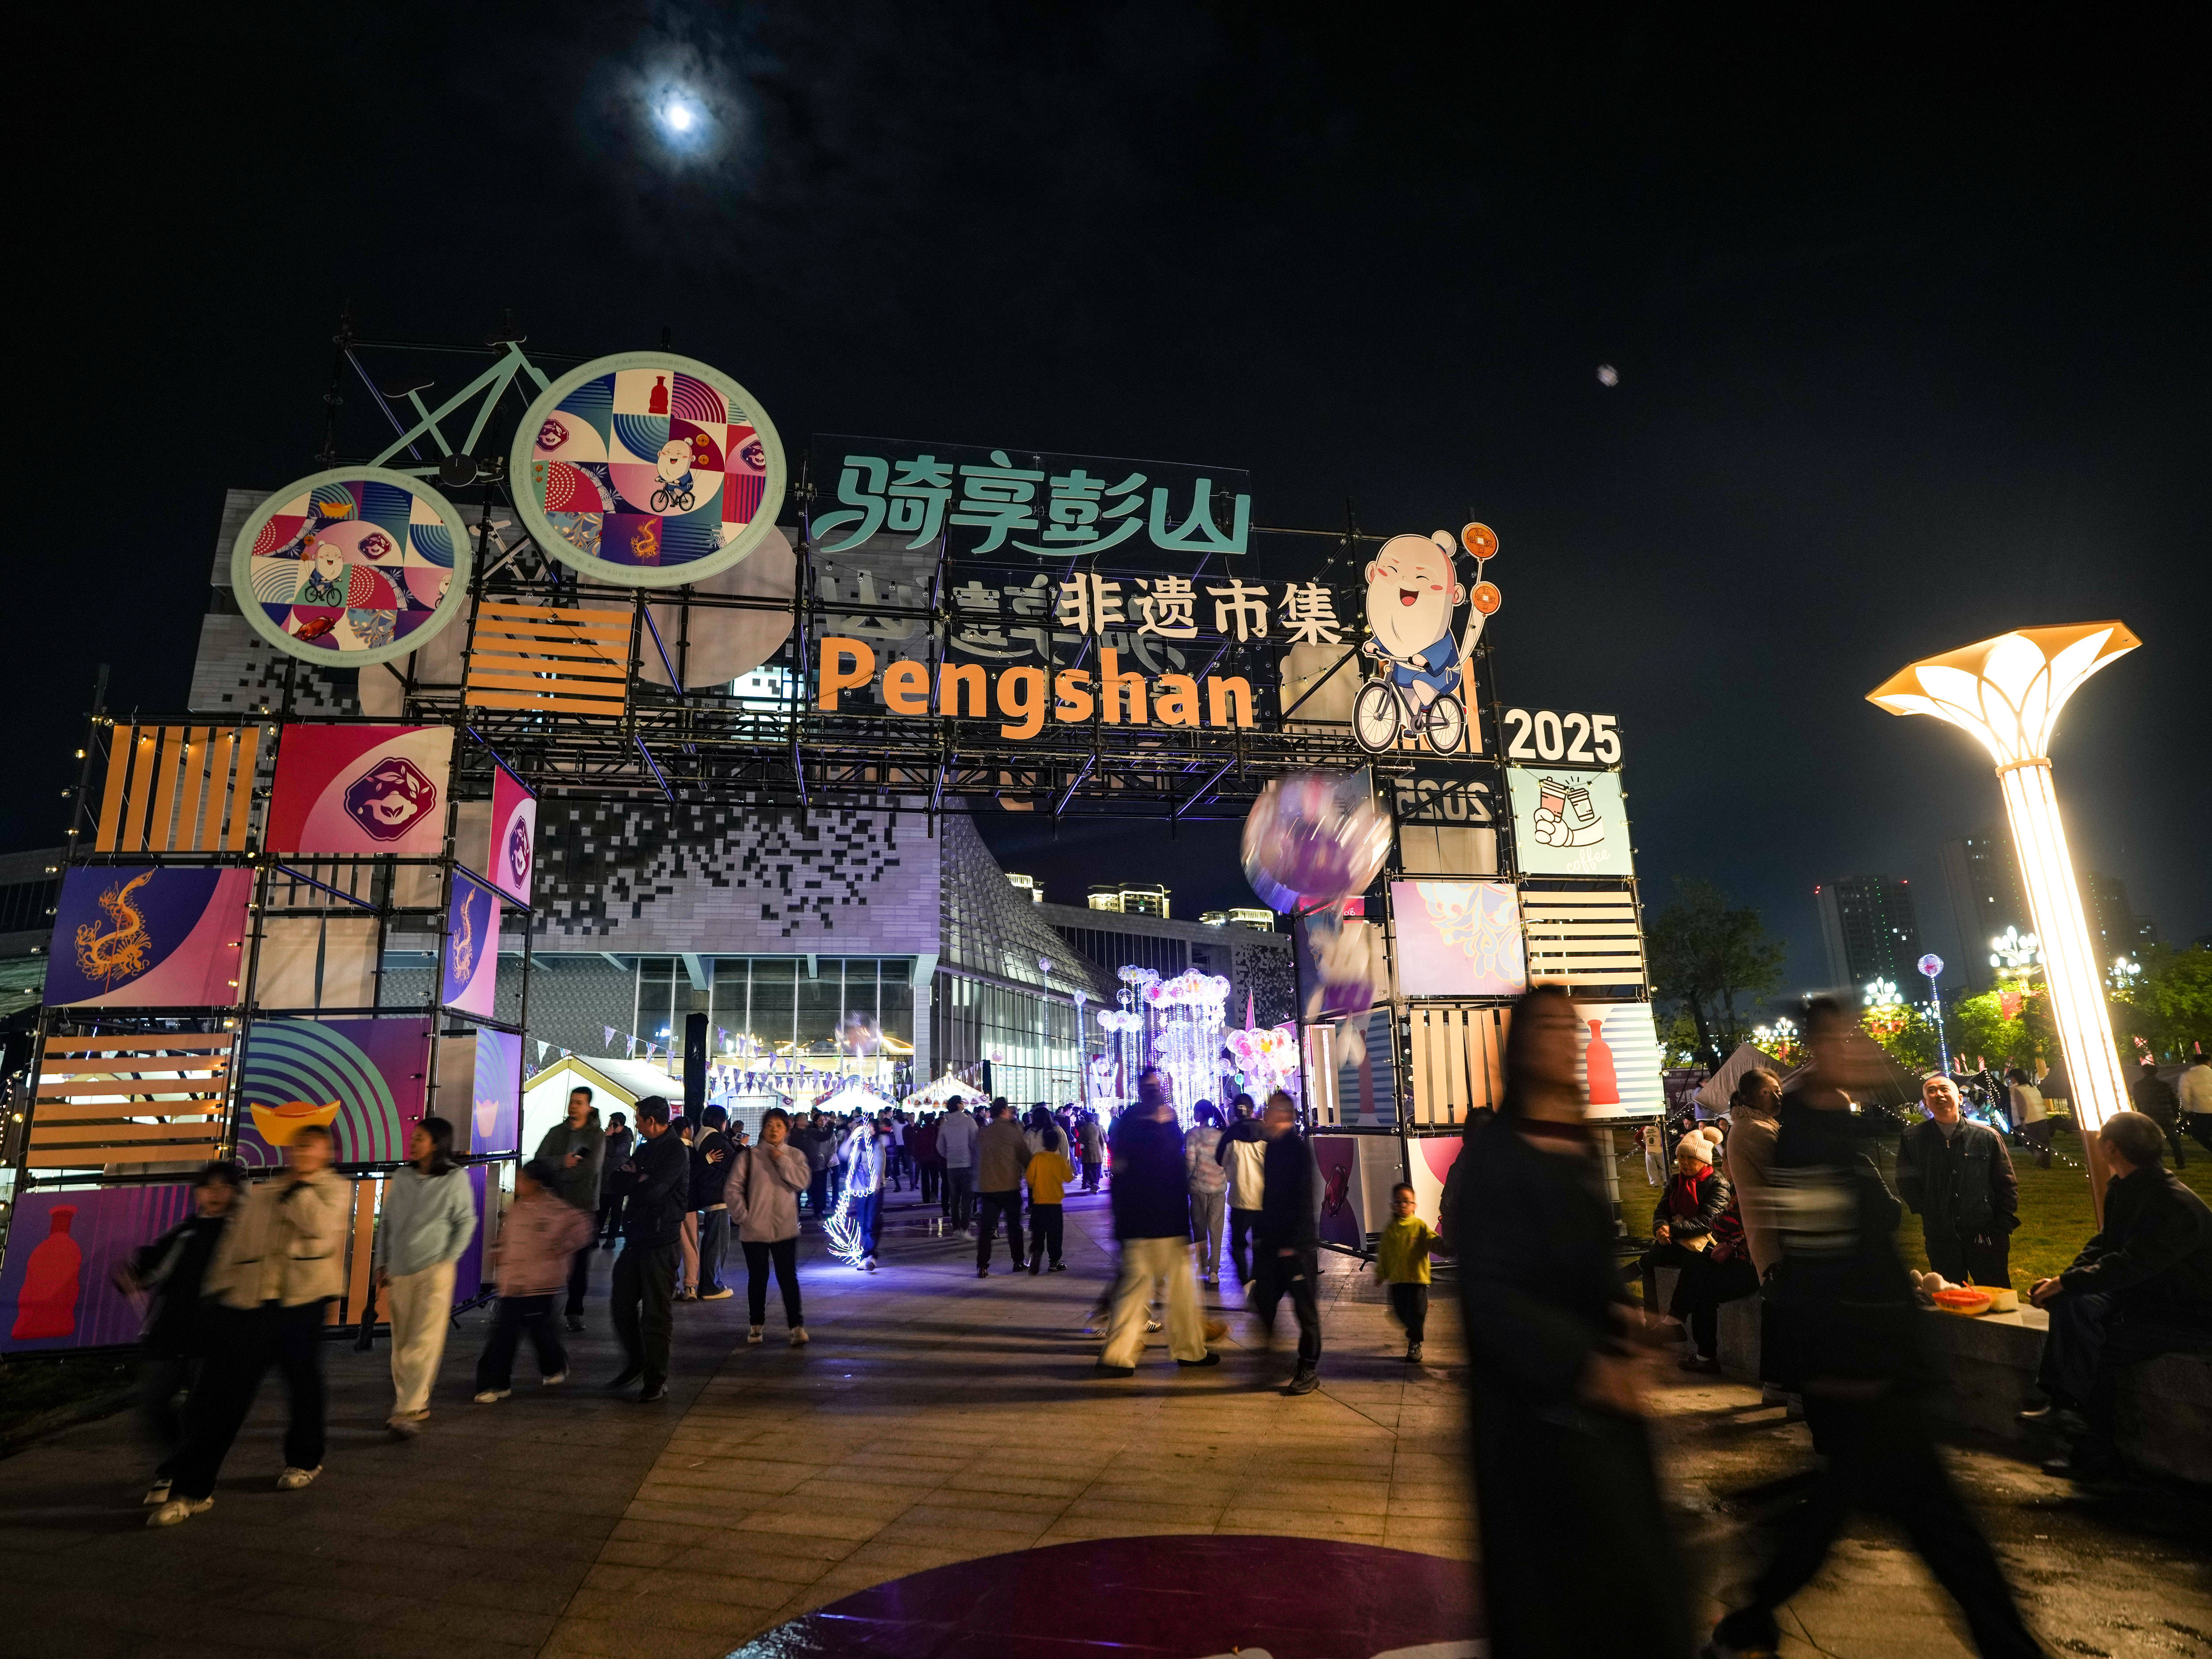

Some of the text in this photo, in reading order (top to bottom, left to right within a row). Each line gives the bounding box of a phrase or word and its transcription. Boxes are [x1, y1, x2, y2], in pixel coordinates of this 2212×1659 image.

[811, 450, 1250, 555] 骑享彭山
[1060, 572, 1341, 646] 非遗市集
[818, 637, 1253, 739] Pengshan
[1505, 709, 1621, 763] 2025
[1567, 846, 1611, 873] coffee
